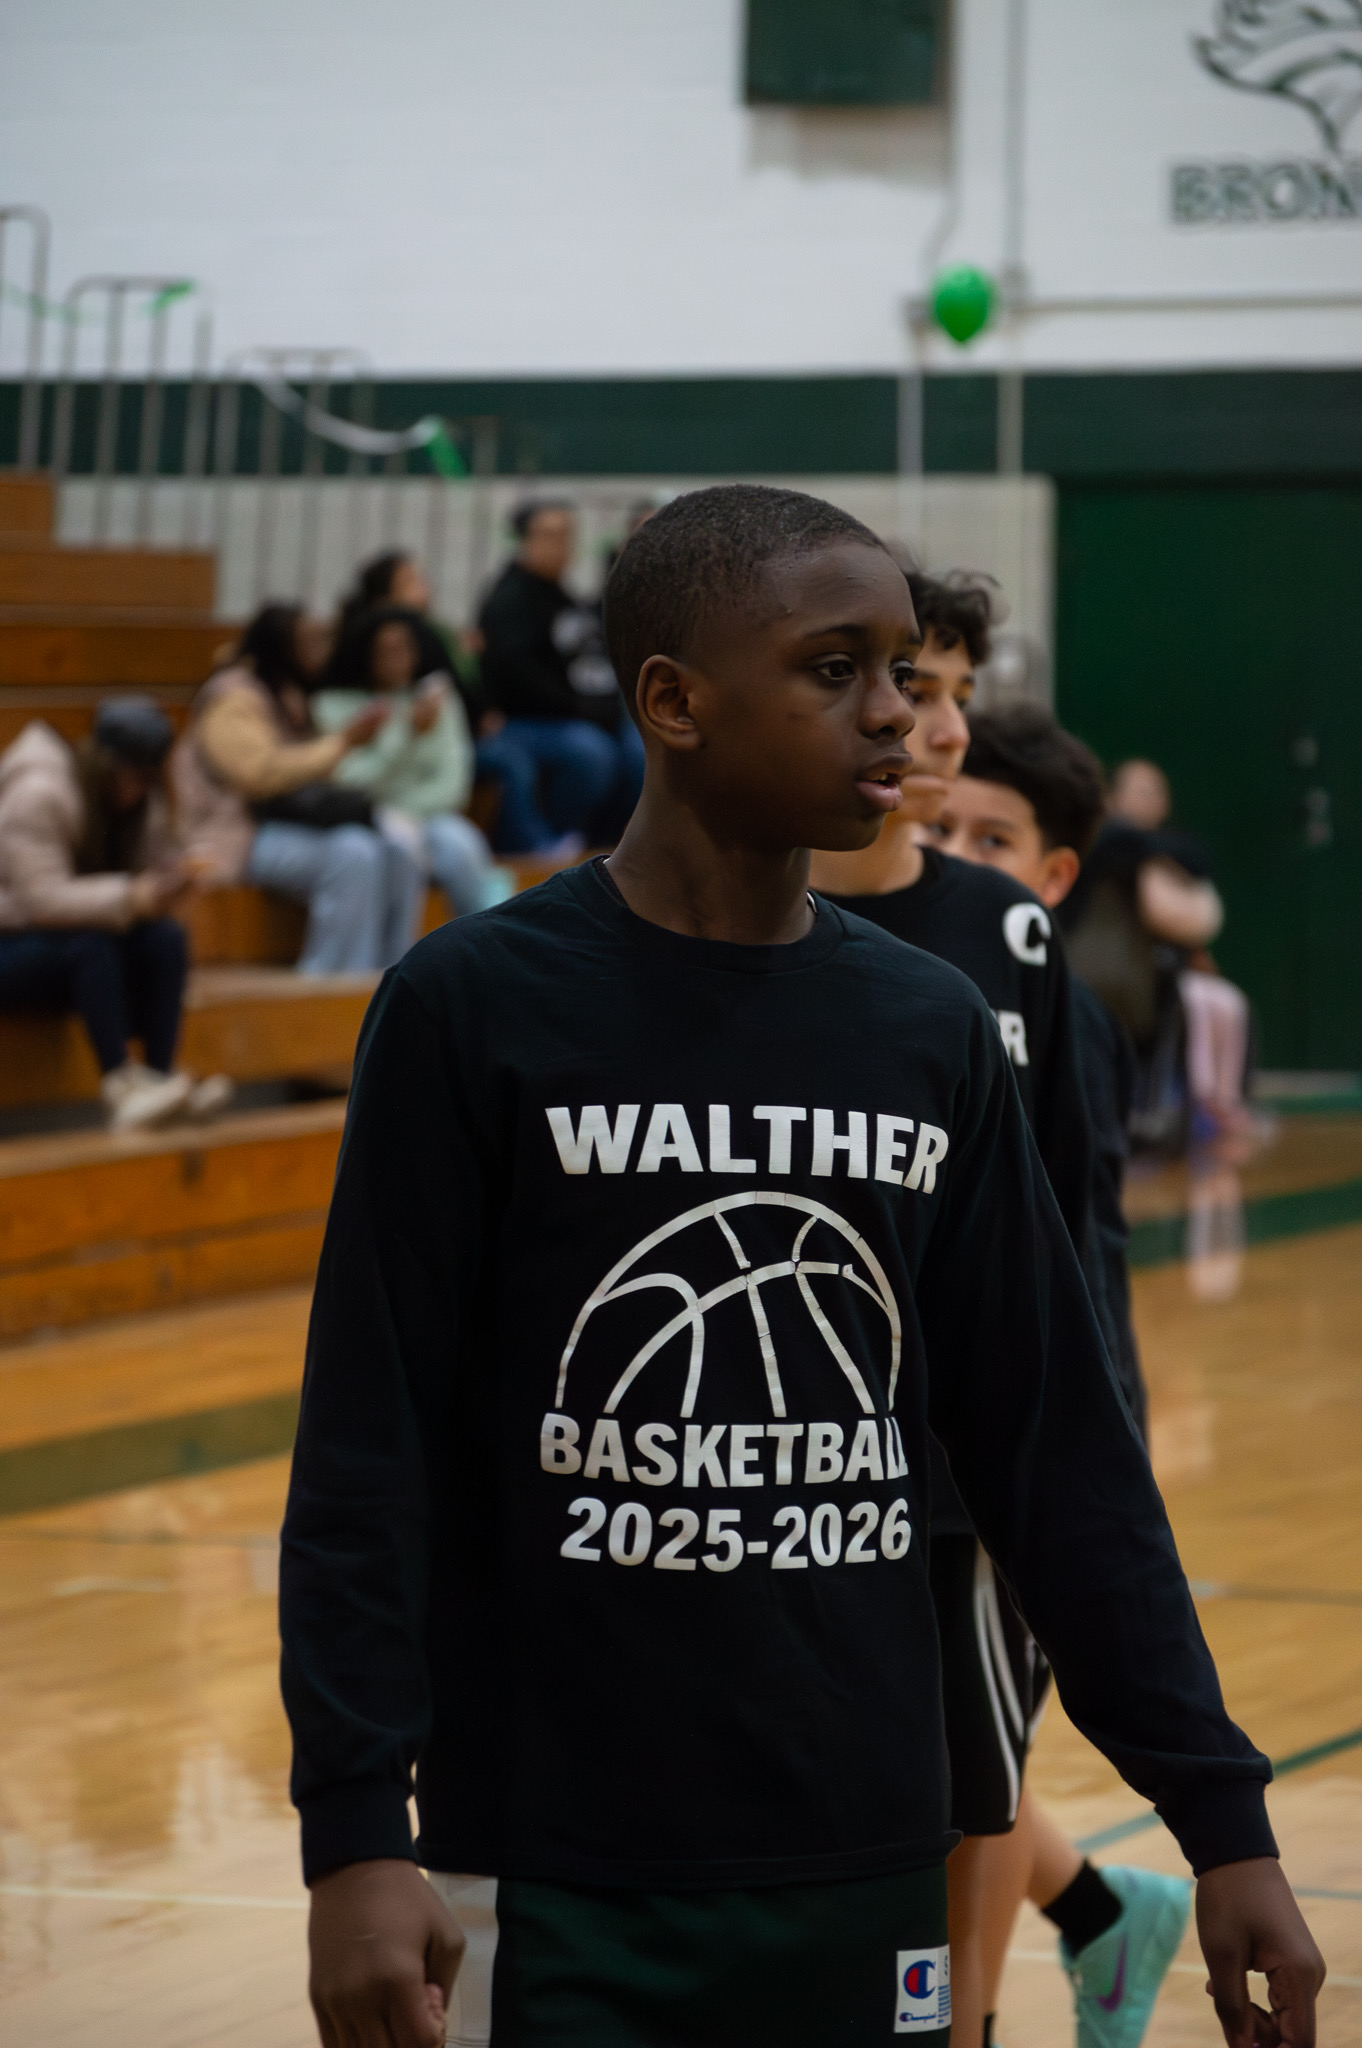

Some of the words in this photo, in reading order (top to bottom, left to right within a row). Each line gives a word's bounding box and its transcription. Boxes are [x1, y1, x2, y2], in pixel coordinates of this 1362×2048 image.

[1003, 902, 1051, 966] C
[545, 1103, 949, 1194] WALTHER
[560, 1497, 912, 1572] 2025-2026
